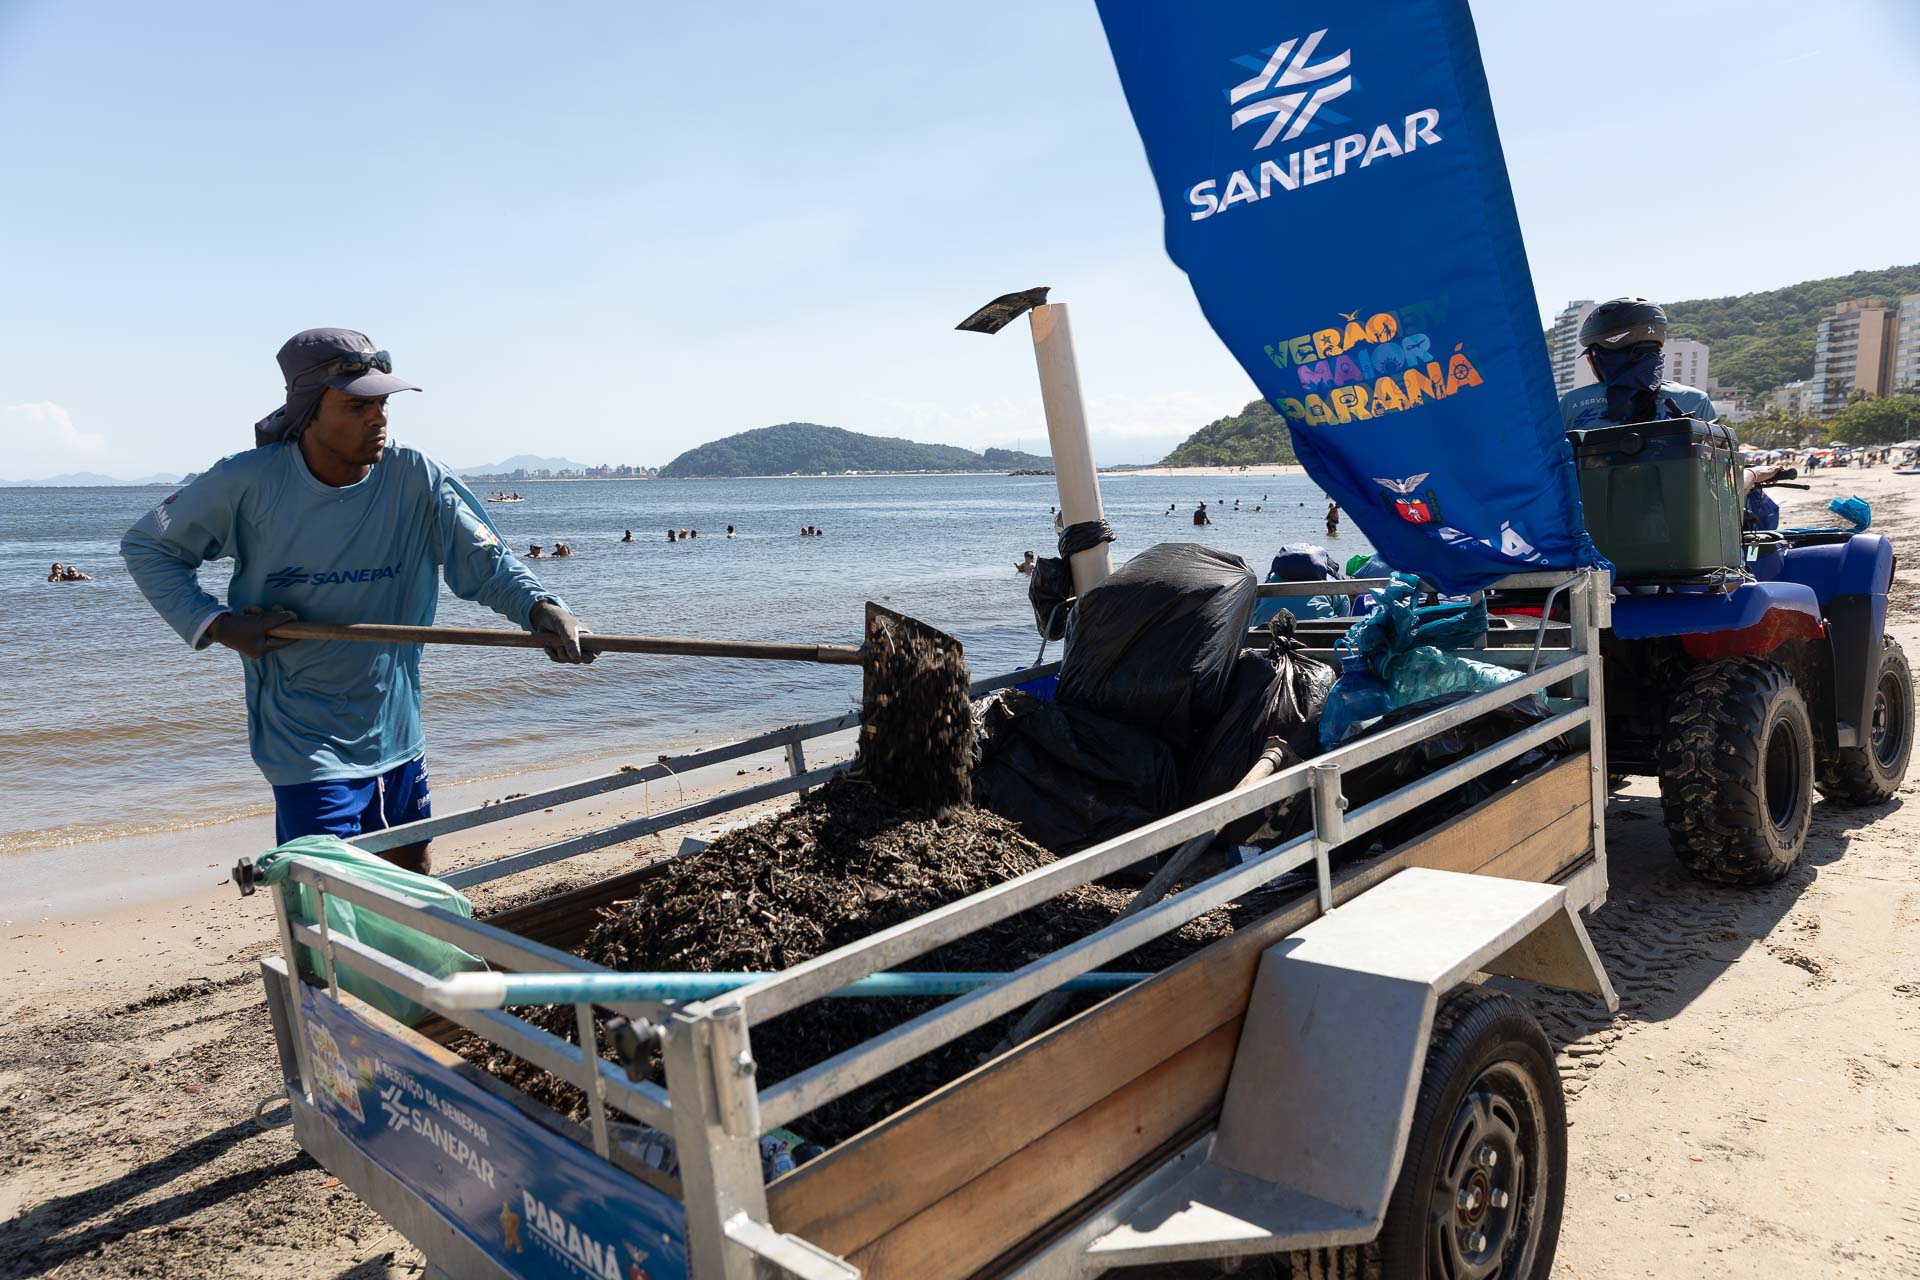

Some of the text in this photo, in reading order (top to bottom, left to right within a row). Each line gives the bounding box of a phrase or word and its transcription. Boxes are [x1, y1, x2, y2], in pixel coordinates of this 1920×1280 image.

[1189, 108, 1443, 221] SANEPAR
[1263, 309, 1398, 369] VERÃO
[1297, 333, 1434, 390] MAIOR
[381, 1063, 424, 1100] SERVIÇO
[425, 1089, 441, 1112] DA
[411, 1108, 496, 1190] SANEPAR
[522, 1190, 624, 1280] PARANÁ
